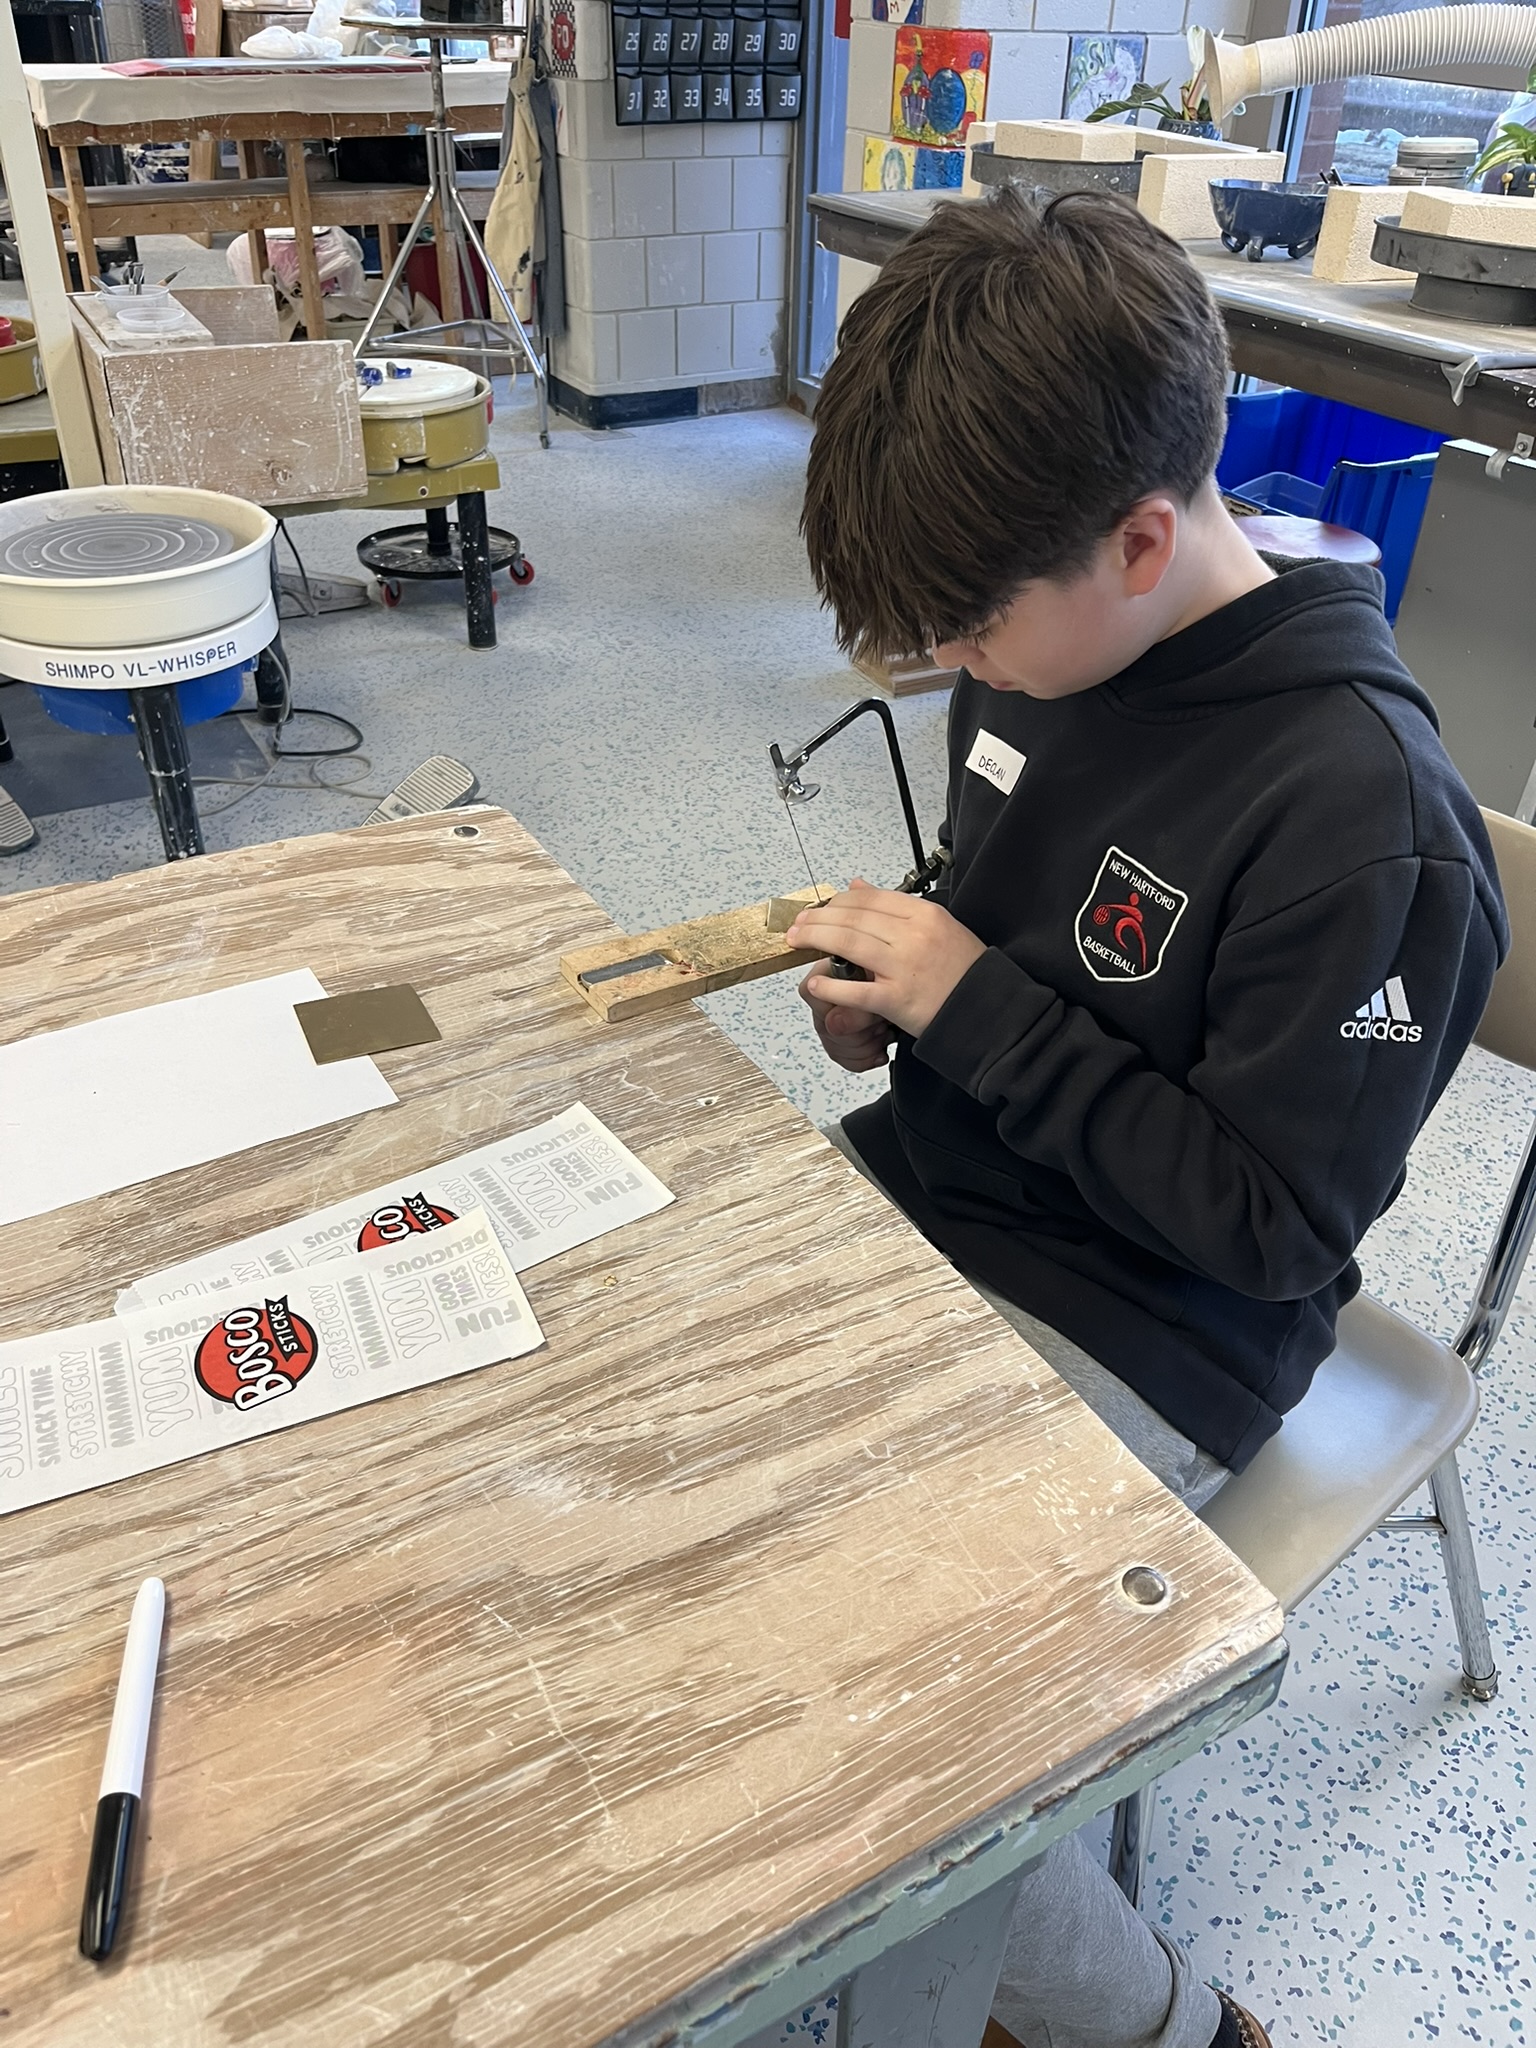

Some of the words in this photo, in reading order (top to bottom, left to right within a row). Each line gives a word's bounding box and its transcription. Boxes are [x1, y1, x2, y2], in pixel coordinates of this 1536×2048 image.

[625, 33, 640, 51] 25
[652, 33, 668, 51] 26
[680, 33, 698, 51] 27
[712, 33, 729, 51] 28
[744, 34, 762, 52] 29
[778, 33, 797, 51] 30
[626, 91, 641, 111] 31
[652, 90, 668, 108] 32
[683, 89, 700, 108] 33
[713, 88, 730, 106] 34
[745, 88, 761, 107] 35
[778, 89, 797, 107] 36
[45, 661, 115, 679] SHIMPO
[123, 641, 237, 678] VL-WHISPER
[1108, 859, 1131, 880] NEW
[1129, 872, 1176, 911] HARTFORD
[1083, 935, 1137, 975] BASKETBALL
[1340, 1015, 1423, 1043] adidas
[501, 1122, 591, 1167] DELICIOUS
[564, 1151, 598, 1182] TIMES
[581, 1136, 623, 1173] YES!
[549, 1157, 583, 1188] GOOD
[584, 1172, 643, 1205] FUN
[409, 1198, 442, 1230] TICKS
[508, 1164, 579, 1229] YUM
[383, 1229, 489, 1279] DELICIOUS
[472, 1248, 510, 1298] YES!
[431, 1272, 461, 1311] GOOD
[450, 1264, 479, 1307] TIMES
[268, 1302, 299, 1353] STICKS
[308, 1284, 359, 1379] STRETCHY
[382, 1279, 442, 1359] YUM
[455, 1300, 522, 1338] FUN
[223, 1308, 295, 1412] BOSCO
[29, 1365, 55, 1411] TIME
[59, 1351, 99, 1459] STRETCHY
[138, 1346, 194, 1437] YUM
[34, 1409, 61, 1468] SNACK
